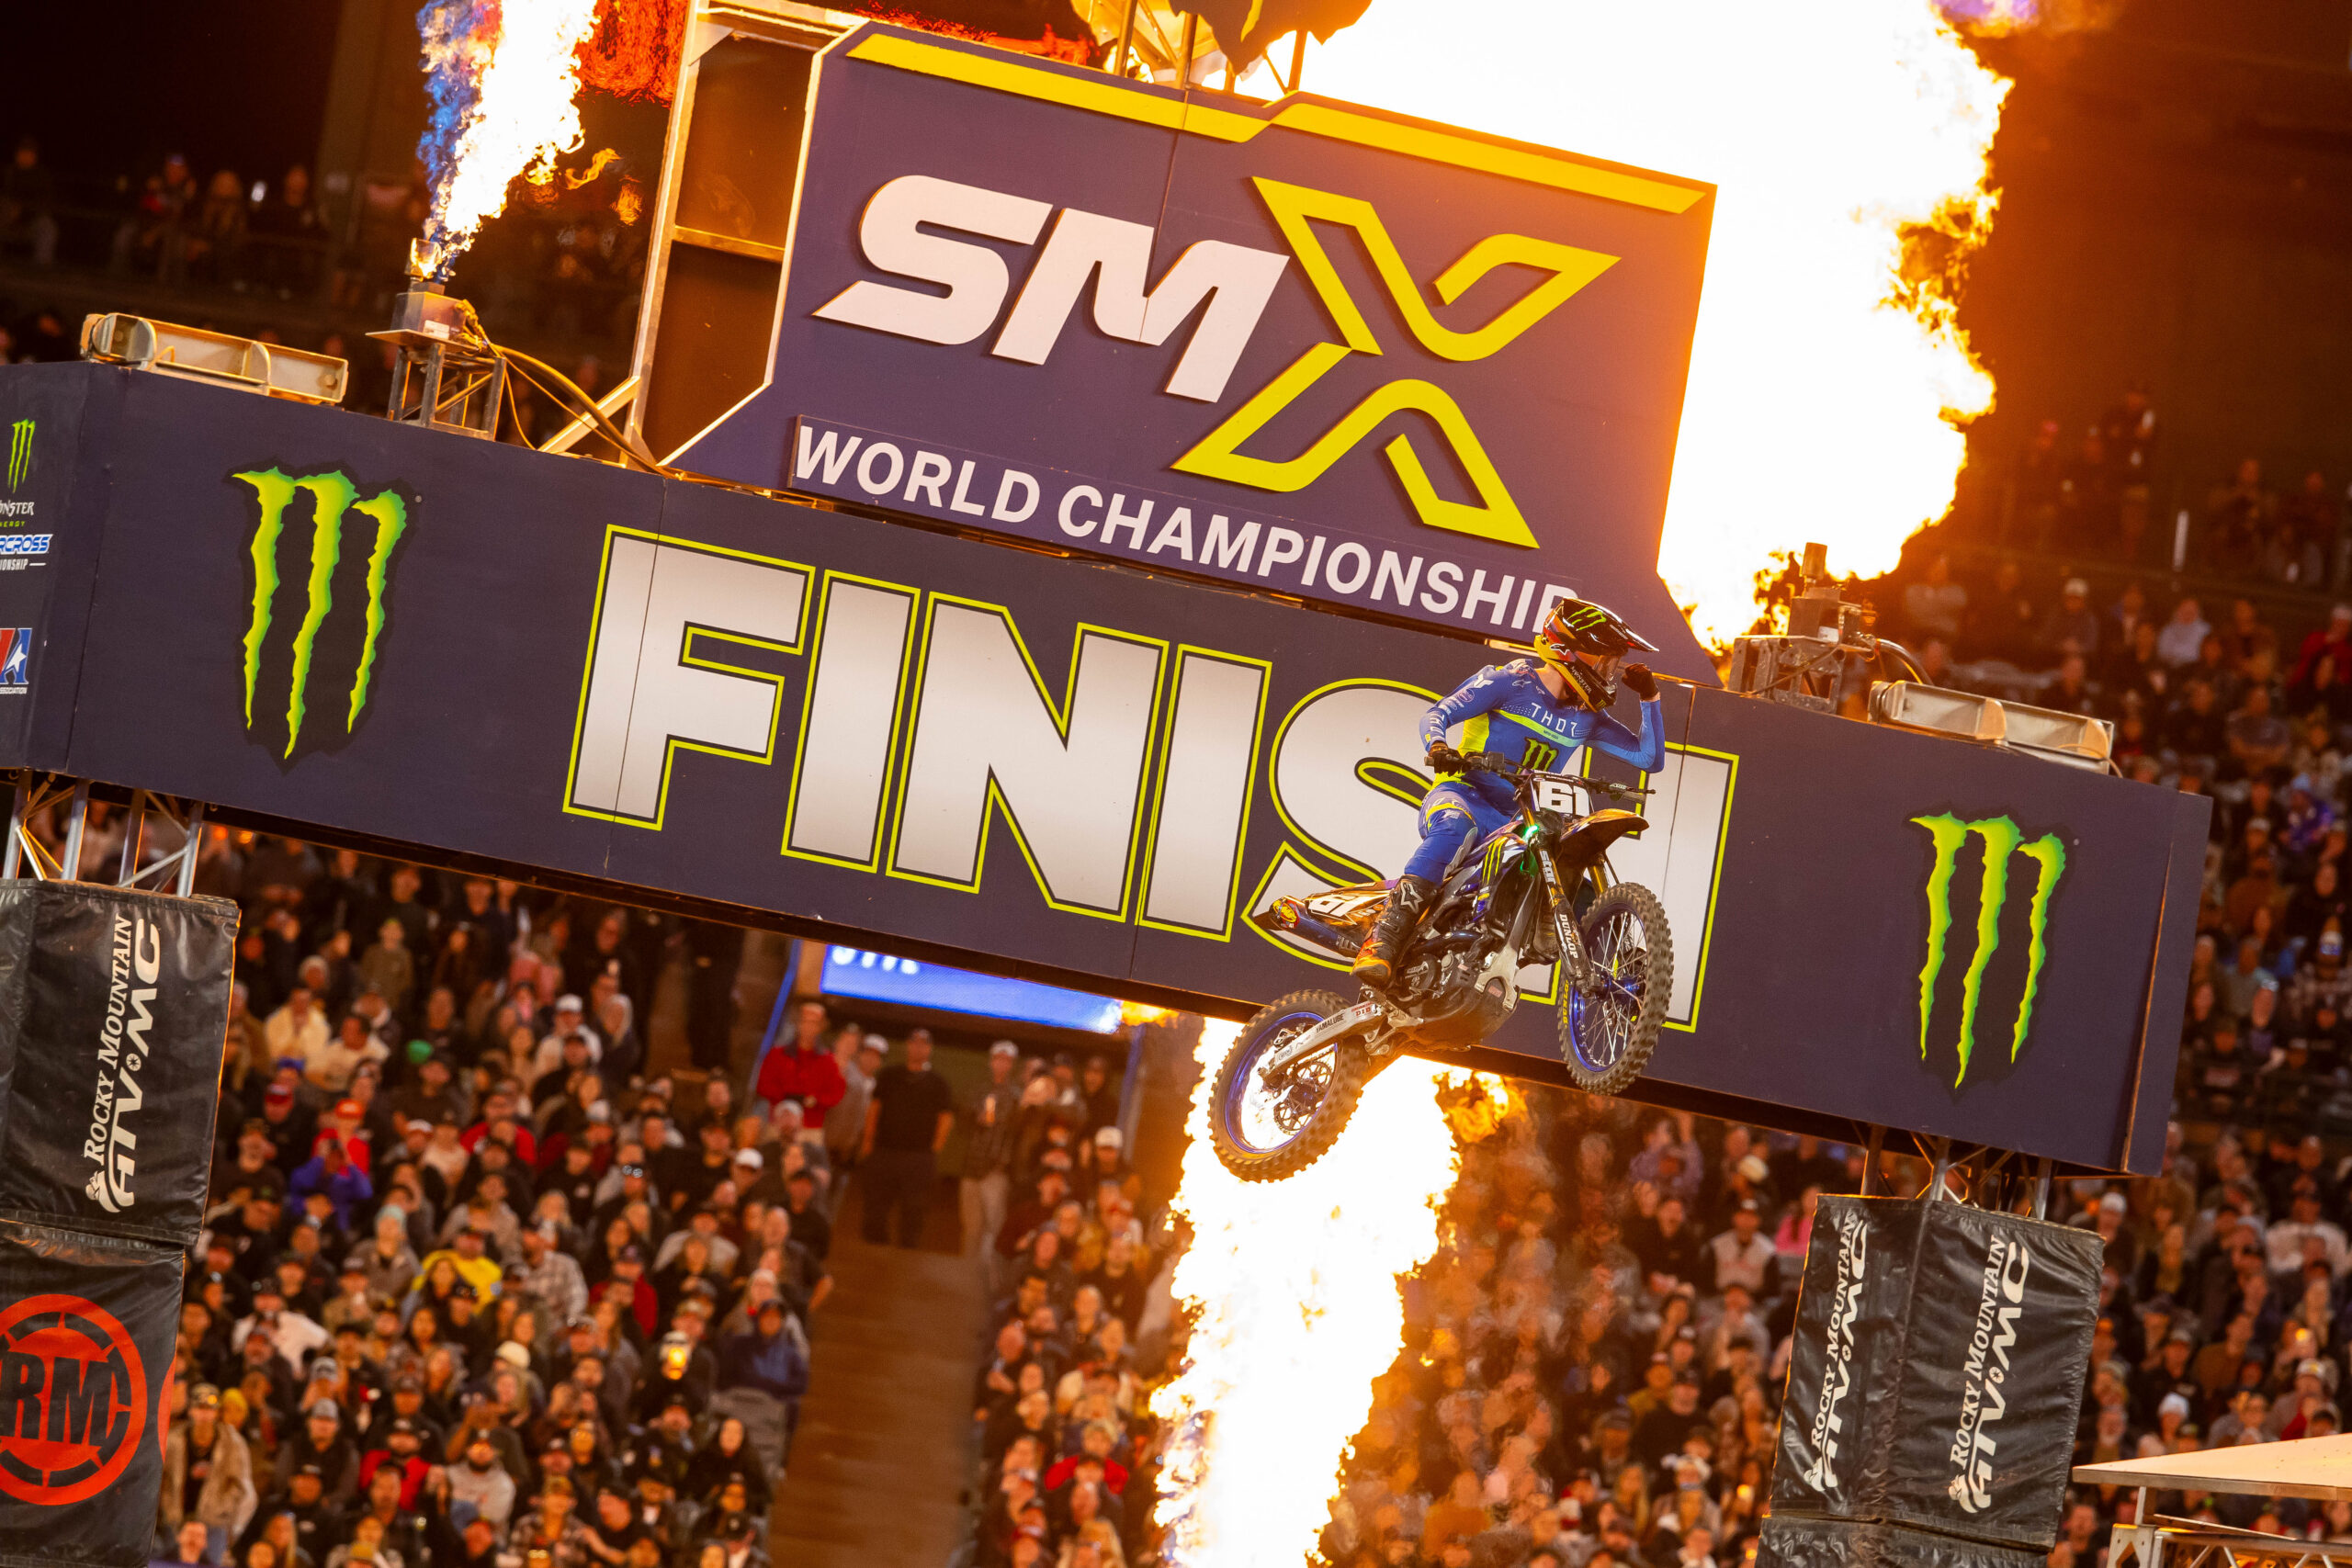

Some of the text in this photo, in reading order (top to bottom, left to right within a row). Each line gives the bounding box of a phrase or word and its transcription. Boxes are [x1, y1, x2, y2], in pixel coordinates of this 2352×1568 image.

[814, 175, 1621, 548] SMX
[0, 500, 34, 517] ONSTER
[796, 425, 1577, 637] WORLD CHAMPIONSHIP
[1539, 780, 1590, 818] 61
[83, 914, 132, 1166] ROCKY MOUNTAIN
[1316, 1013, 1346, 1033] YAMALUBE
[1559, 914, 1578, 959] DUNLOP
[1811, 1208, 1859, 1451] ROCKY MOUNTAIN
[1950, 1235, 2007, 1470] ROCKY MOUNTAIN
